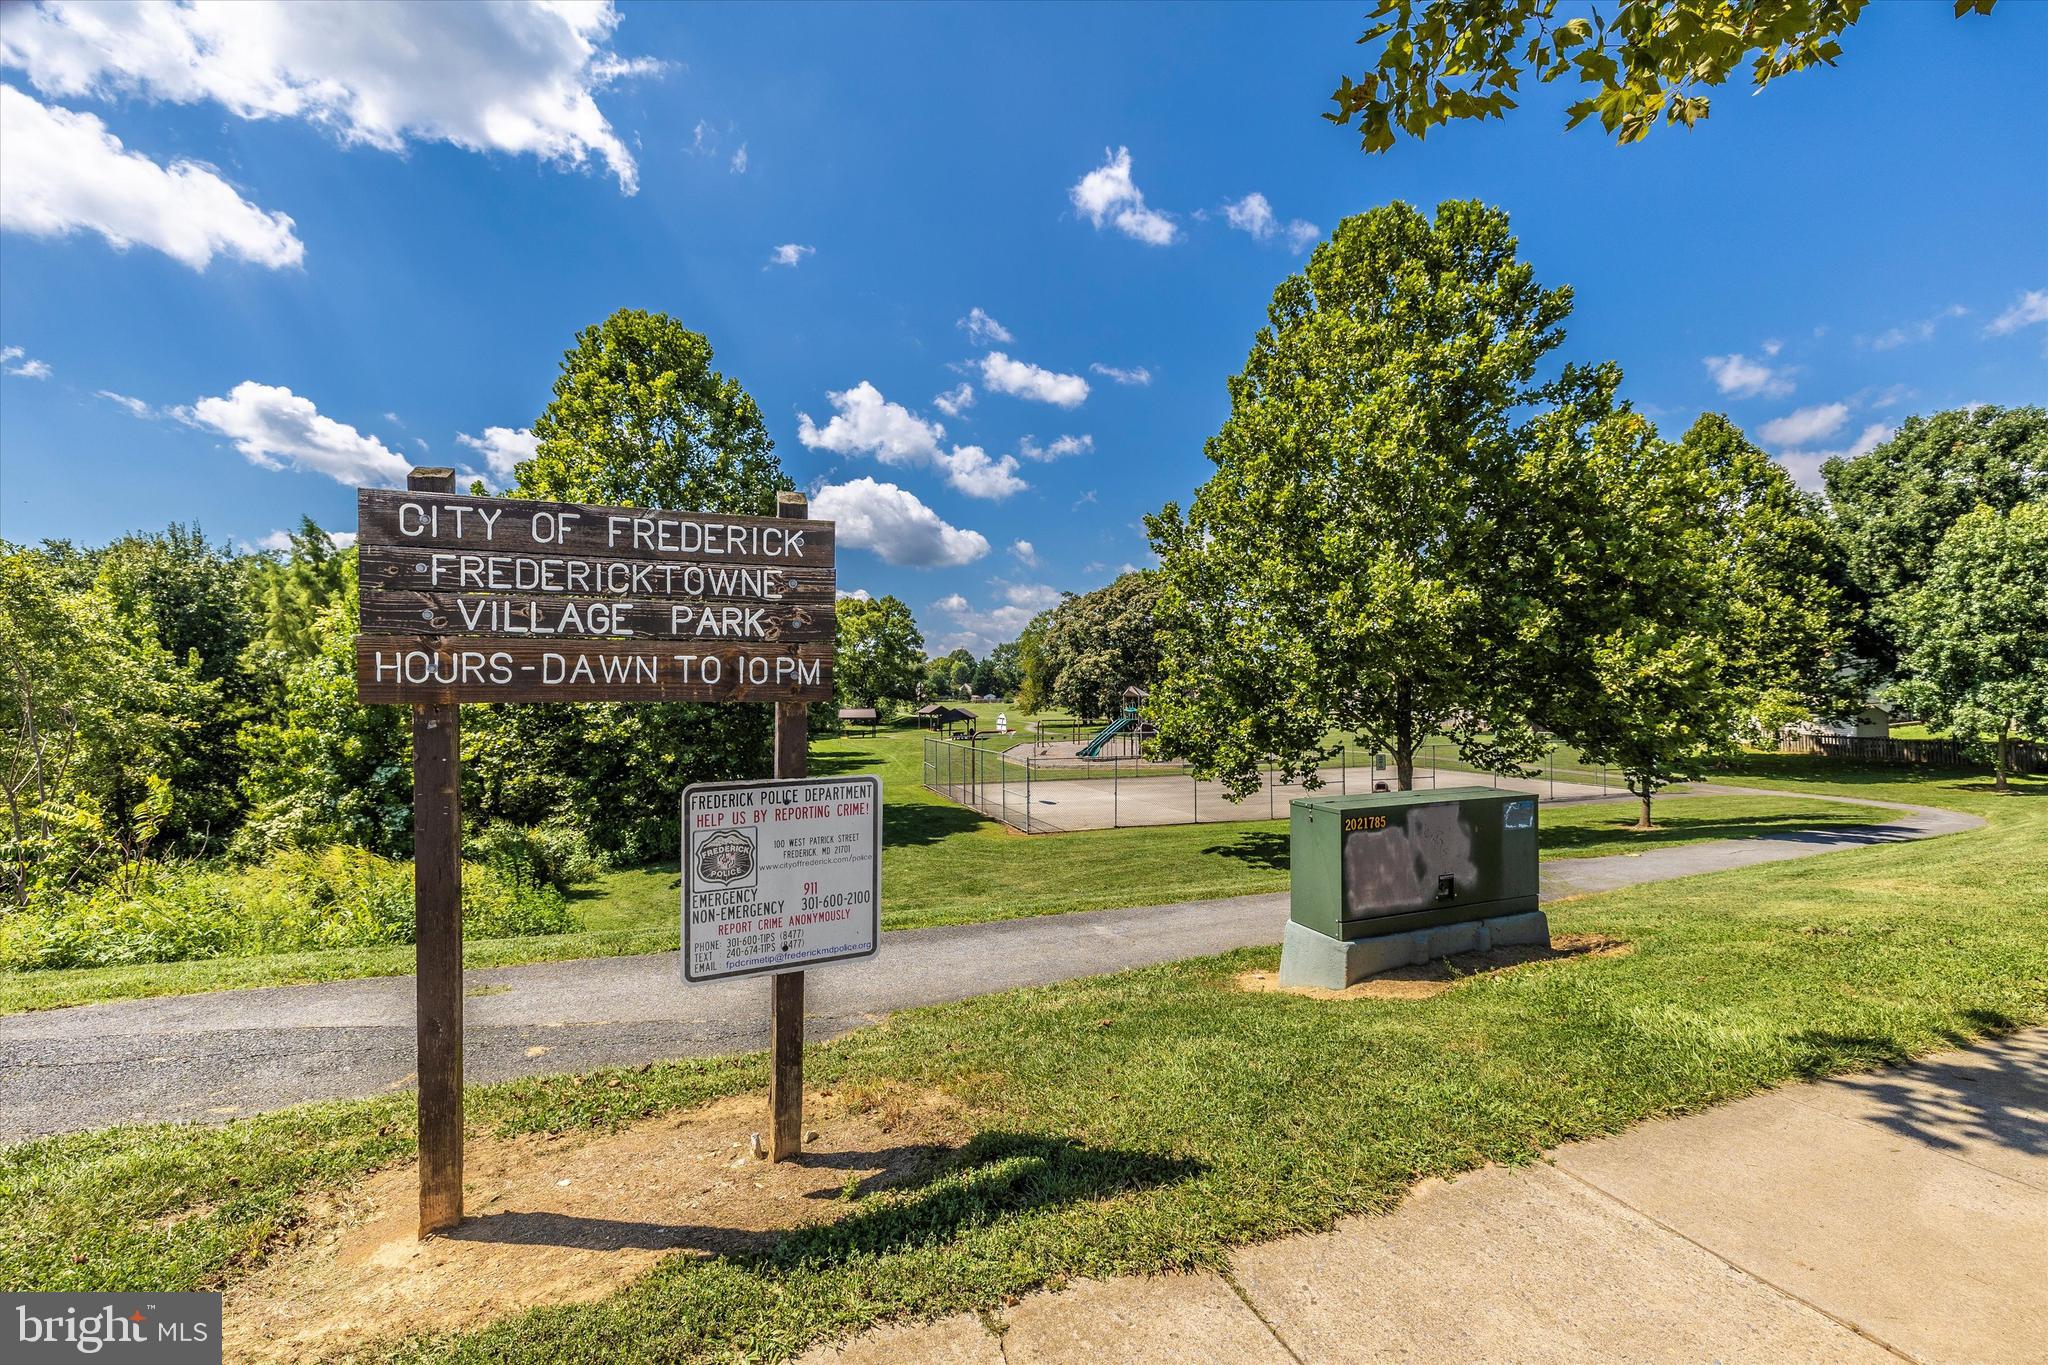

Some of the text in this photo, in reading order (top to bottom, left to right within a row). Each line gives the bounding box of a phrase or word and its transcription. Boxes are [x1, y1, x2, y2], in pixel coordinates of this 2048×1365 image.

[399, 503, 804, 558] CITY OF FREDERICK
[431, 554, 783, 599] FREDERICKTOWNE
[457, 599, 765, 637] VILLAGE PARK
[674, 655, 721, 685] TO
[691, 785, 872, 810] FREDERICK POLICE DEPARTMENT
[697, 803, 869, 828] HELP US BY REPORTING CRIME!
[1345, 815, 1387, 831] 2021785
[701, 844, 750, 859] FREDERICK
[774, 833, 860, 848] 100 WEST PATRICK STREET
[822, 847, 831, 855] MD
[834, 845, 851, 854] 21701
[711, 867, 742, 877] POLICE
[759, 854, 873, 871] www.cityoffrederick.com/police
[692, 882, 818, 909] EMERGENCY 911
[692, 890, 871, 924] NON-EMERGENCY 301-600-2100
[718, 908, 851, 936] REPORT CRIME ANONYMOUSLY
[726, 932, 775, 948] 301-600-TIPS
[780, 929, 804, 940] (8477)
[726, 941, 776, 959] 240-674-TIPS
[726, 941, 872, 969] fpdcrimetip@frederickmdpolice.org
